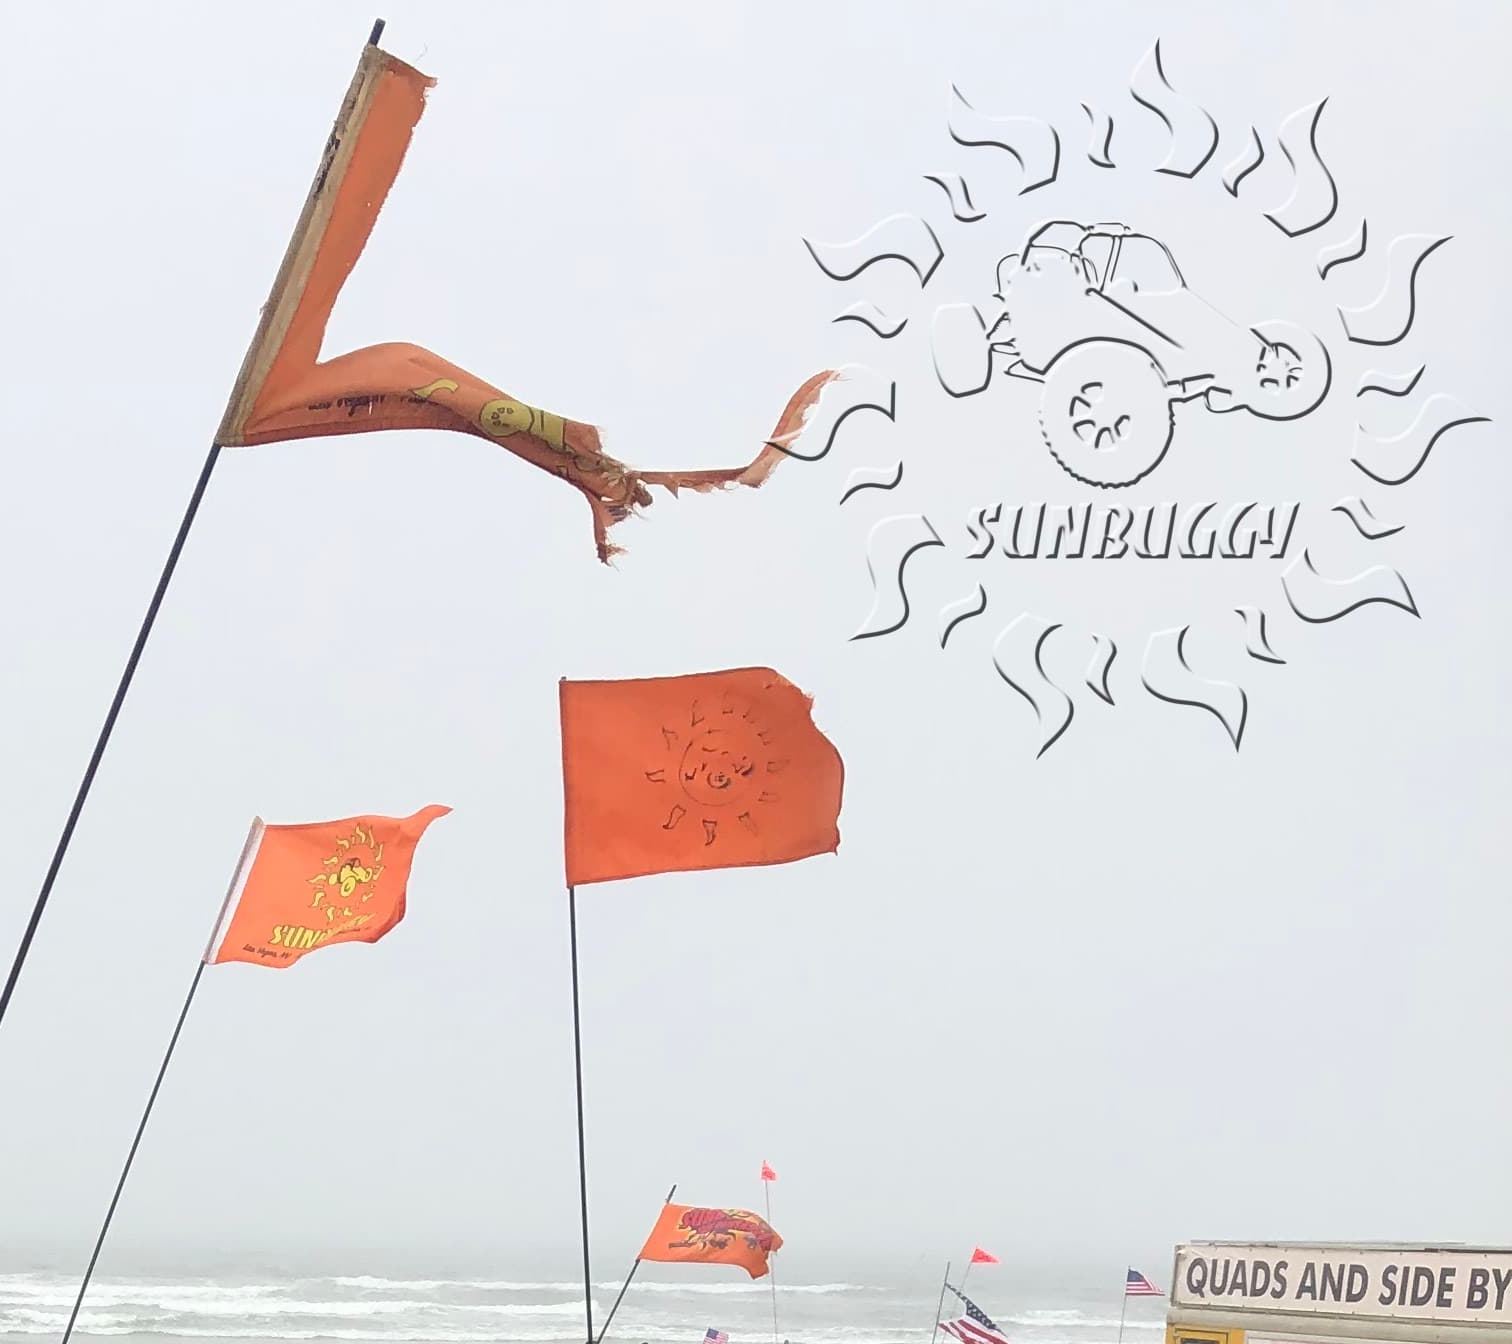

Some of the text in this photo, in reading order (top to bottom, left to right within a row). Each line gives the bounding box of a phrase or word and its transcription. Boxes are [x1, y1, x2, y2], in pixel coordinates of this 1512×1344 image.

[1187, 1257, 1512, 1310] QUADS AND SIDE BY
